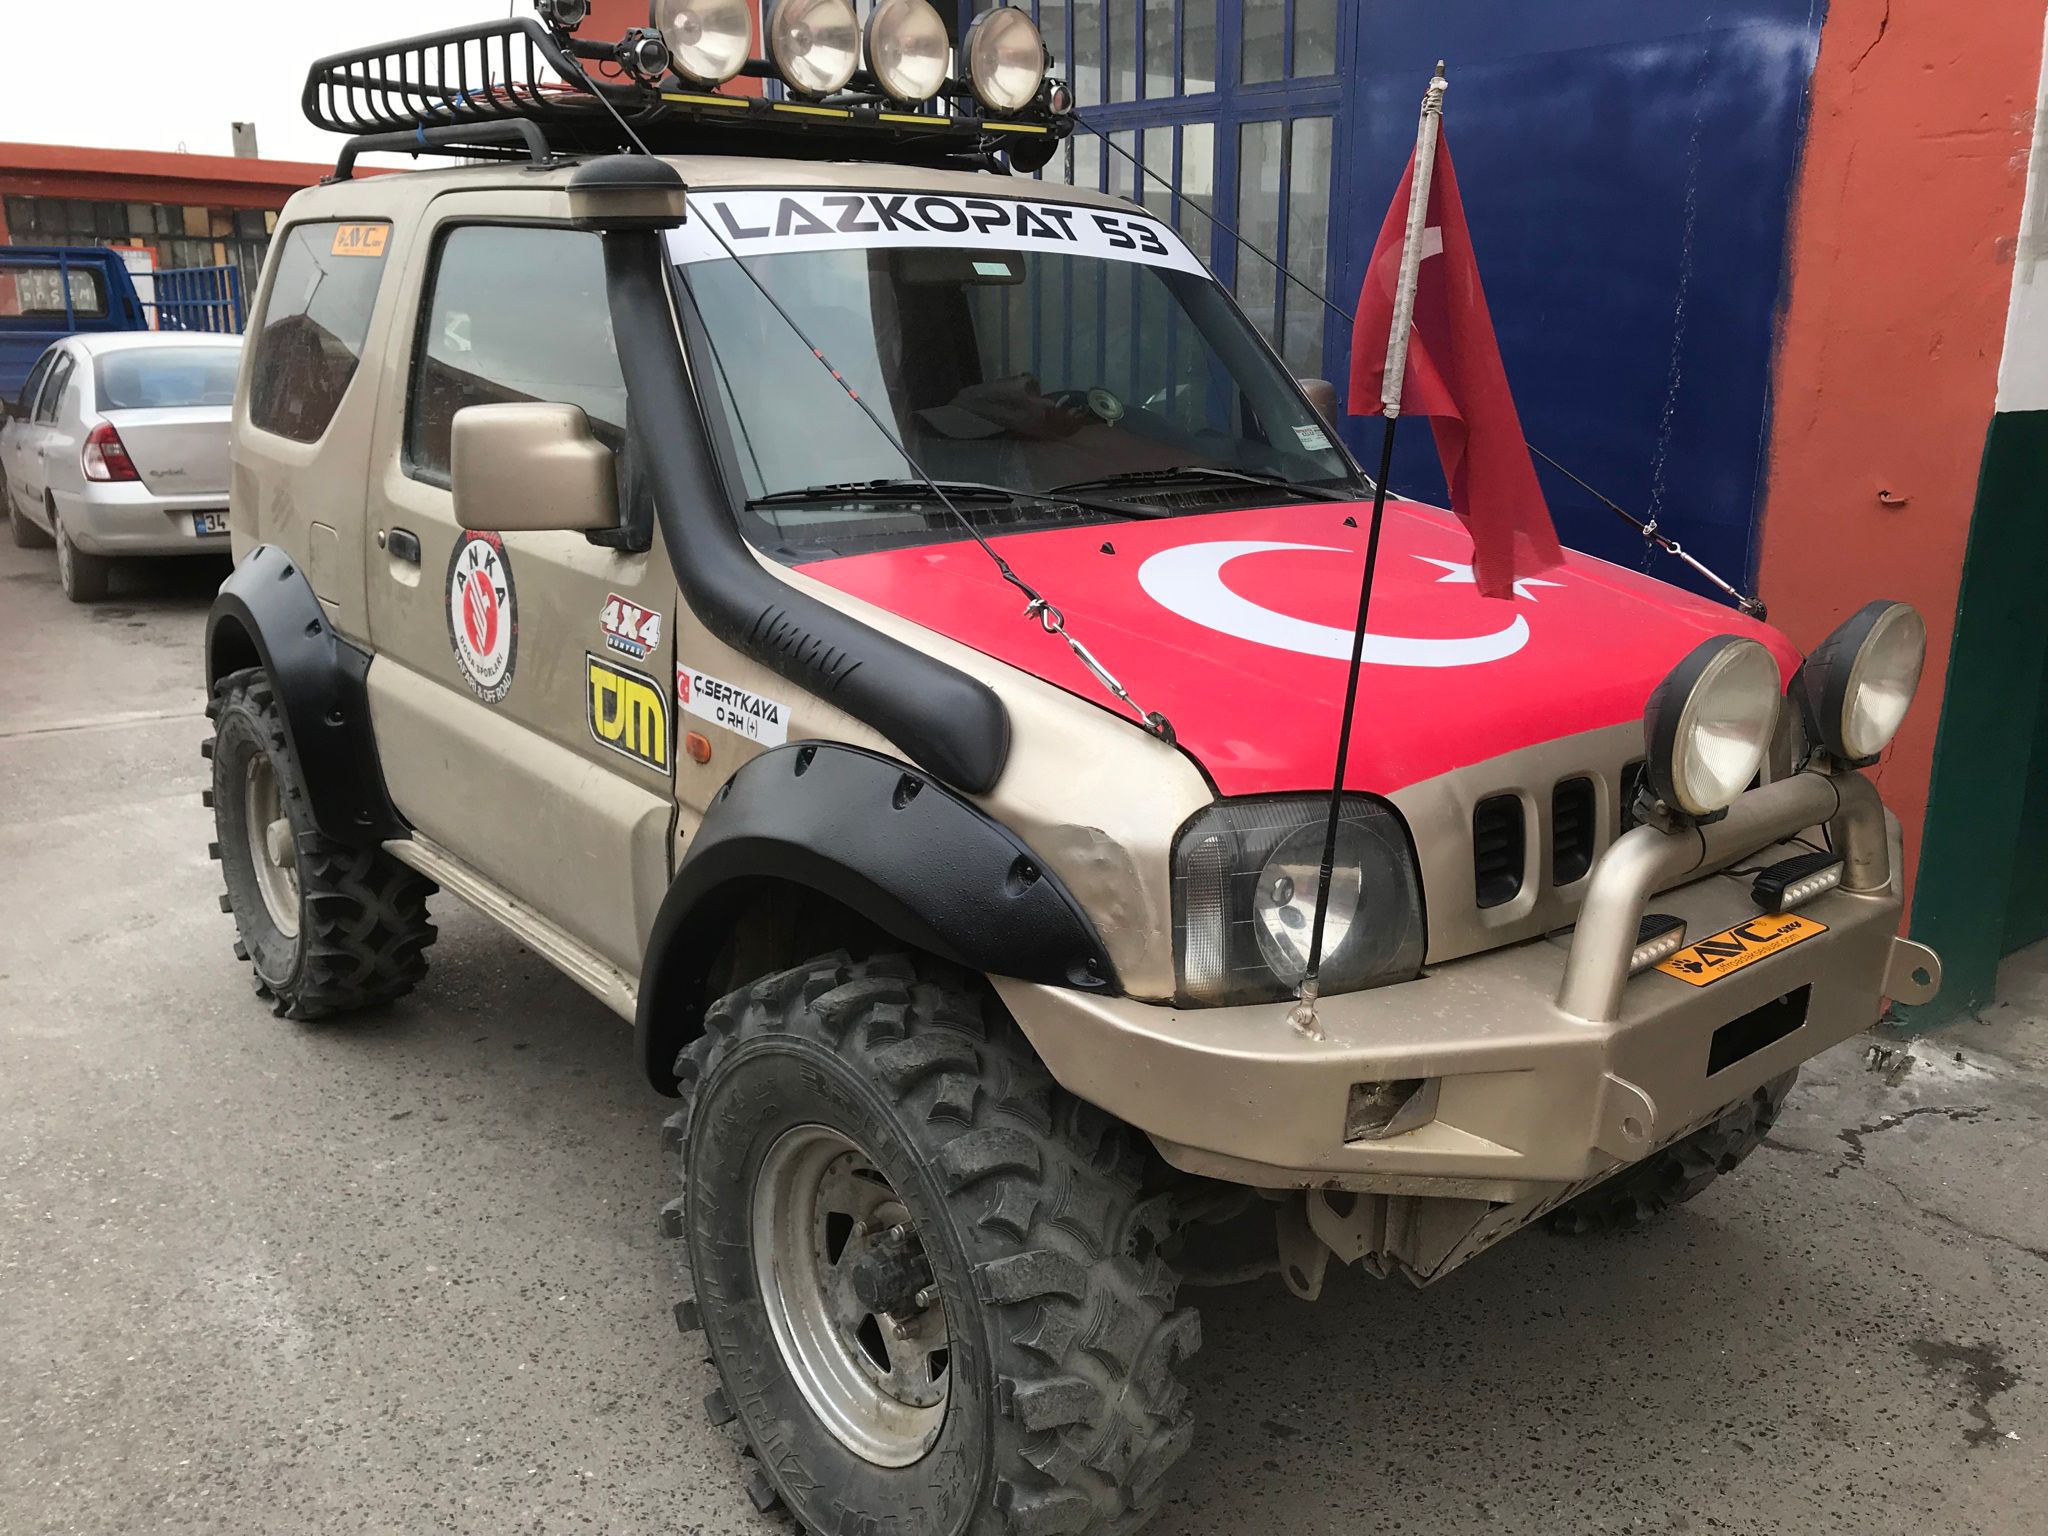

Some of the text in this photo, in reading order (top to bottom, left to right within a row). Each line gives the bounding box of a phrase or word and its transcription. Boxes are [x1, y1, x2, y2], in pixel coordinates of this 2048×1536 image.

[713, 194, 1169, 256] LAZKOPAT 53
[206, 514, 226, 531] 34
[456, 545, 506, 608] ANKA
[495, 672, 512, 701] ROAD
[590, 665, 665, 765] TJM
[727, 711, 744, 730] RH
[746, 716, 758, 739] (+)
